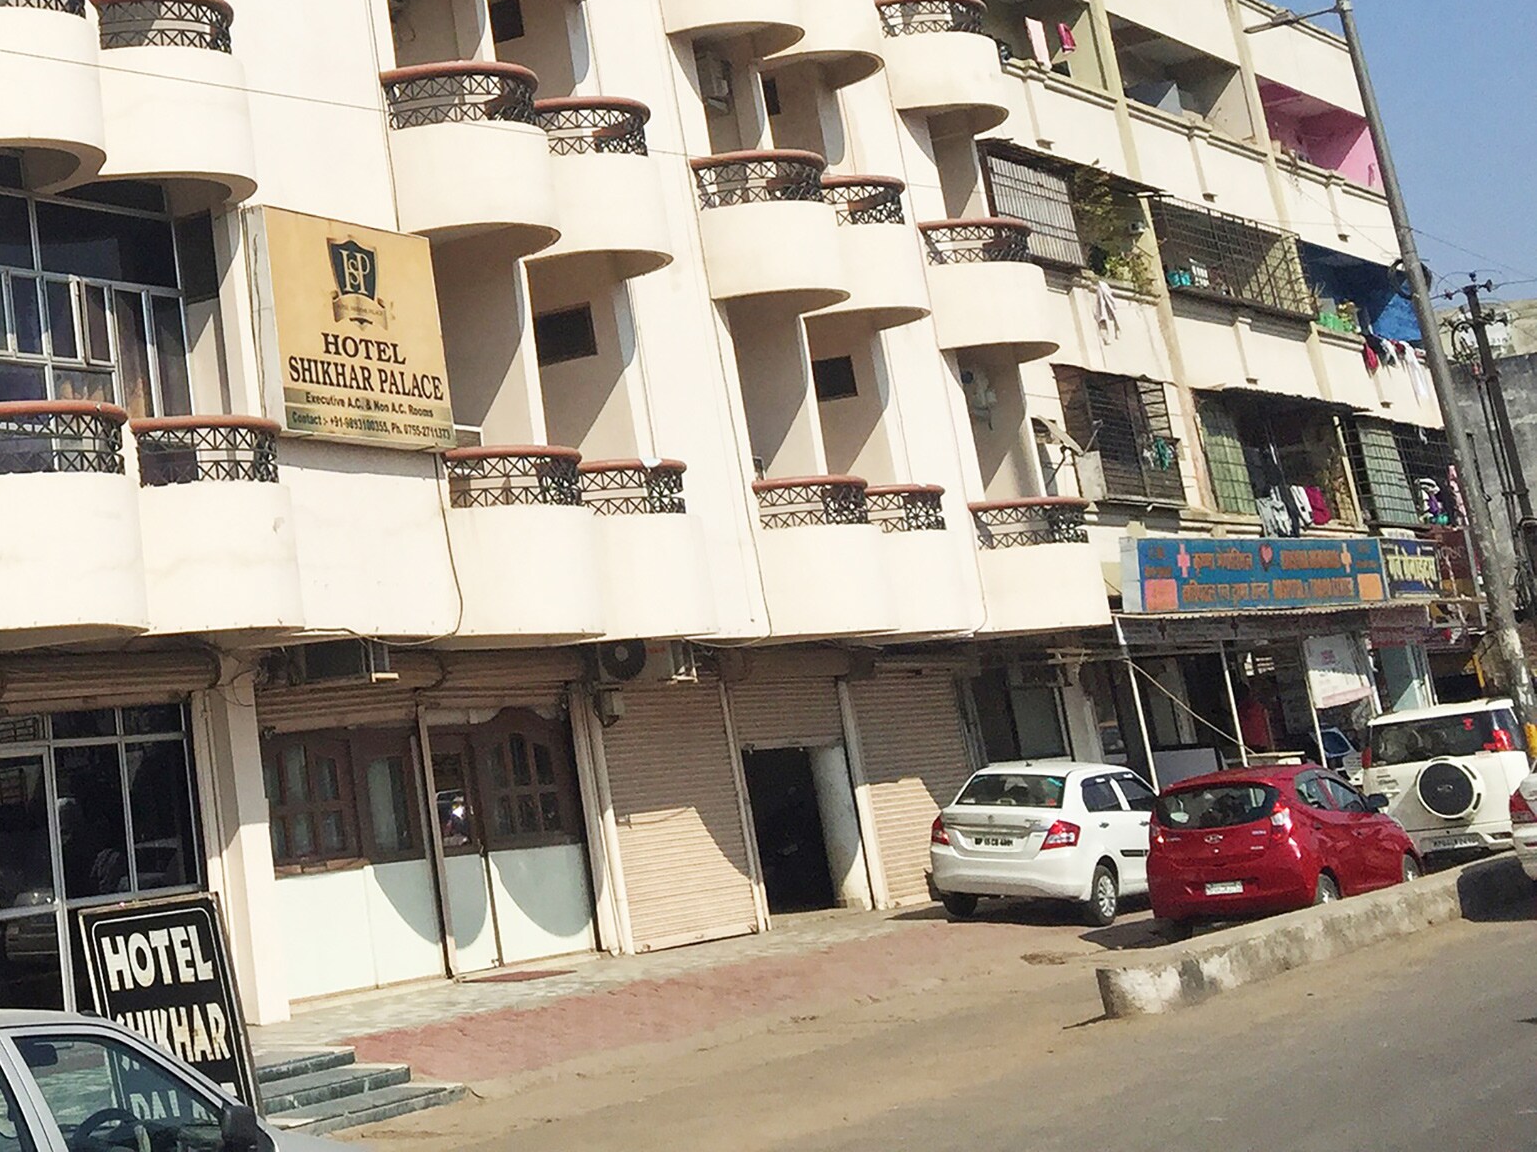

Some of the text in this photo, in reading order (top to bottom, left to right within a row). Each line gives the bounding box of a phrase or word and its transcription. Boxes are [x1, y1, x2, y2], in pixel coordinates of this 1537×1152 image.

[321, 332, 406, 365] HOTEL
[288, 356, 443, 401] SHIKHAR PALACE
[292, 411, 321, 426] Contact
[306, 392, 345, 408] Executive
[348, 398, 363, 410] A.C.
[373, 401, 389, 413] Non
[391, 404, 407, 415] A.C.
[408, 406, 433, 418] Rooms
[101, 925, 214, 992] HOTEL
